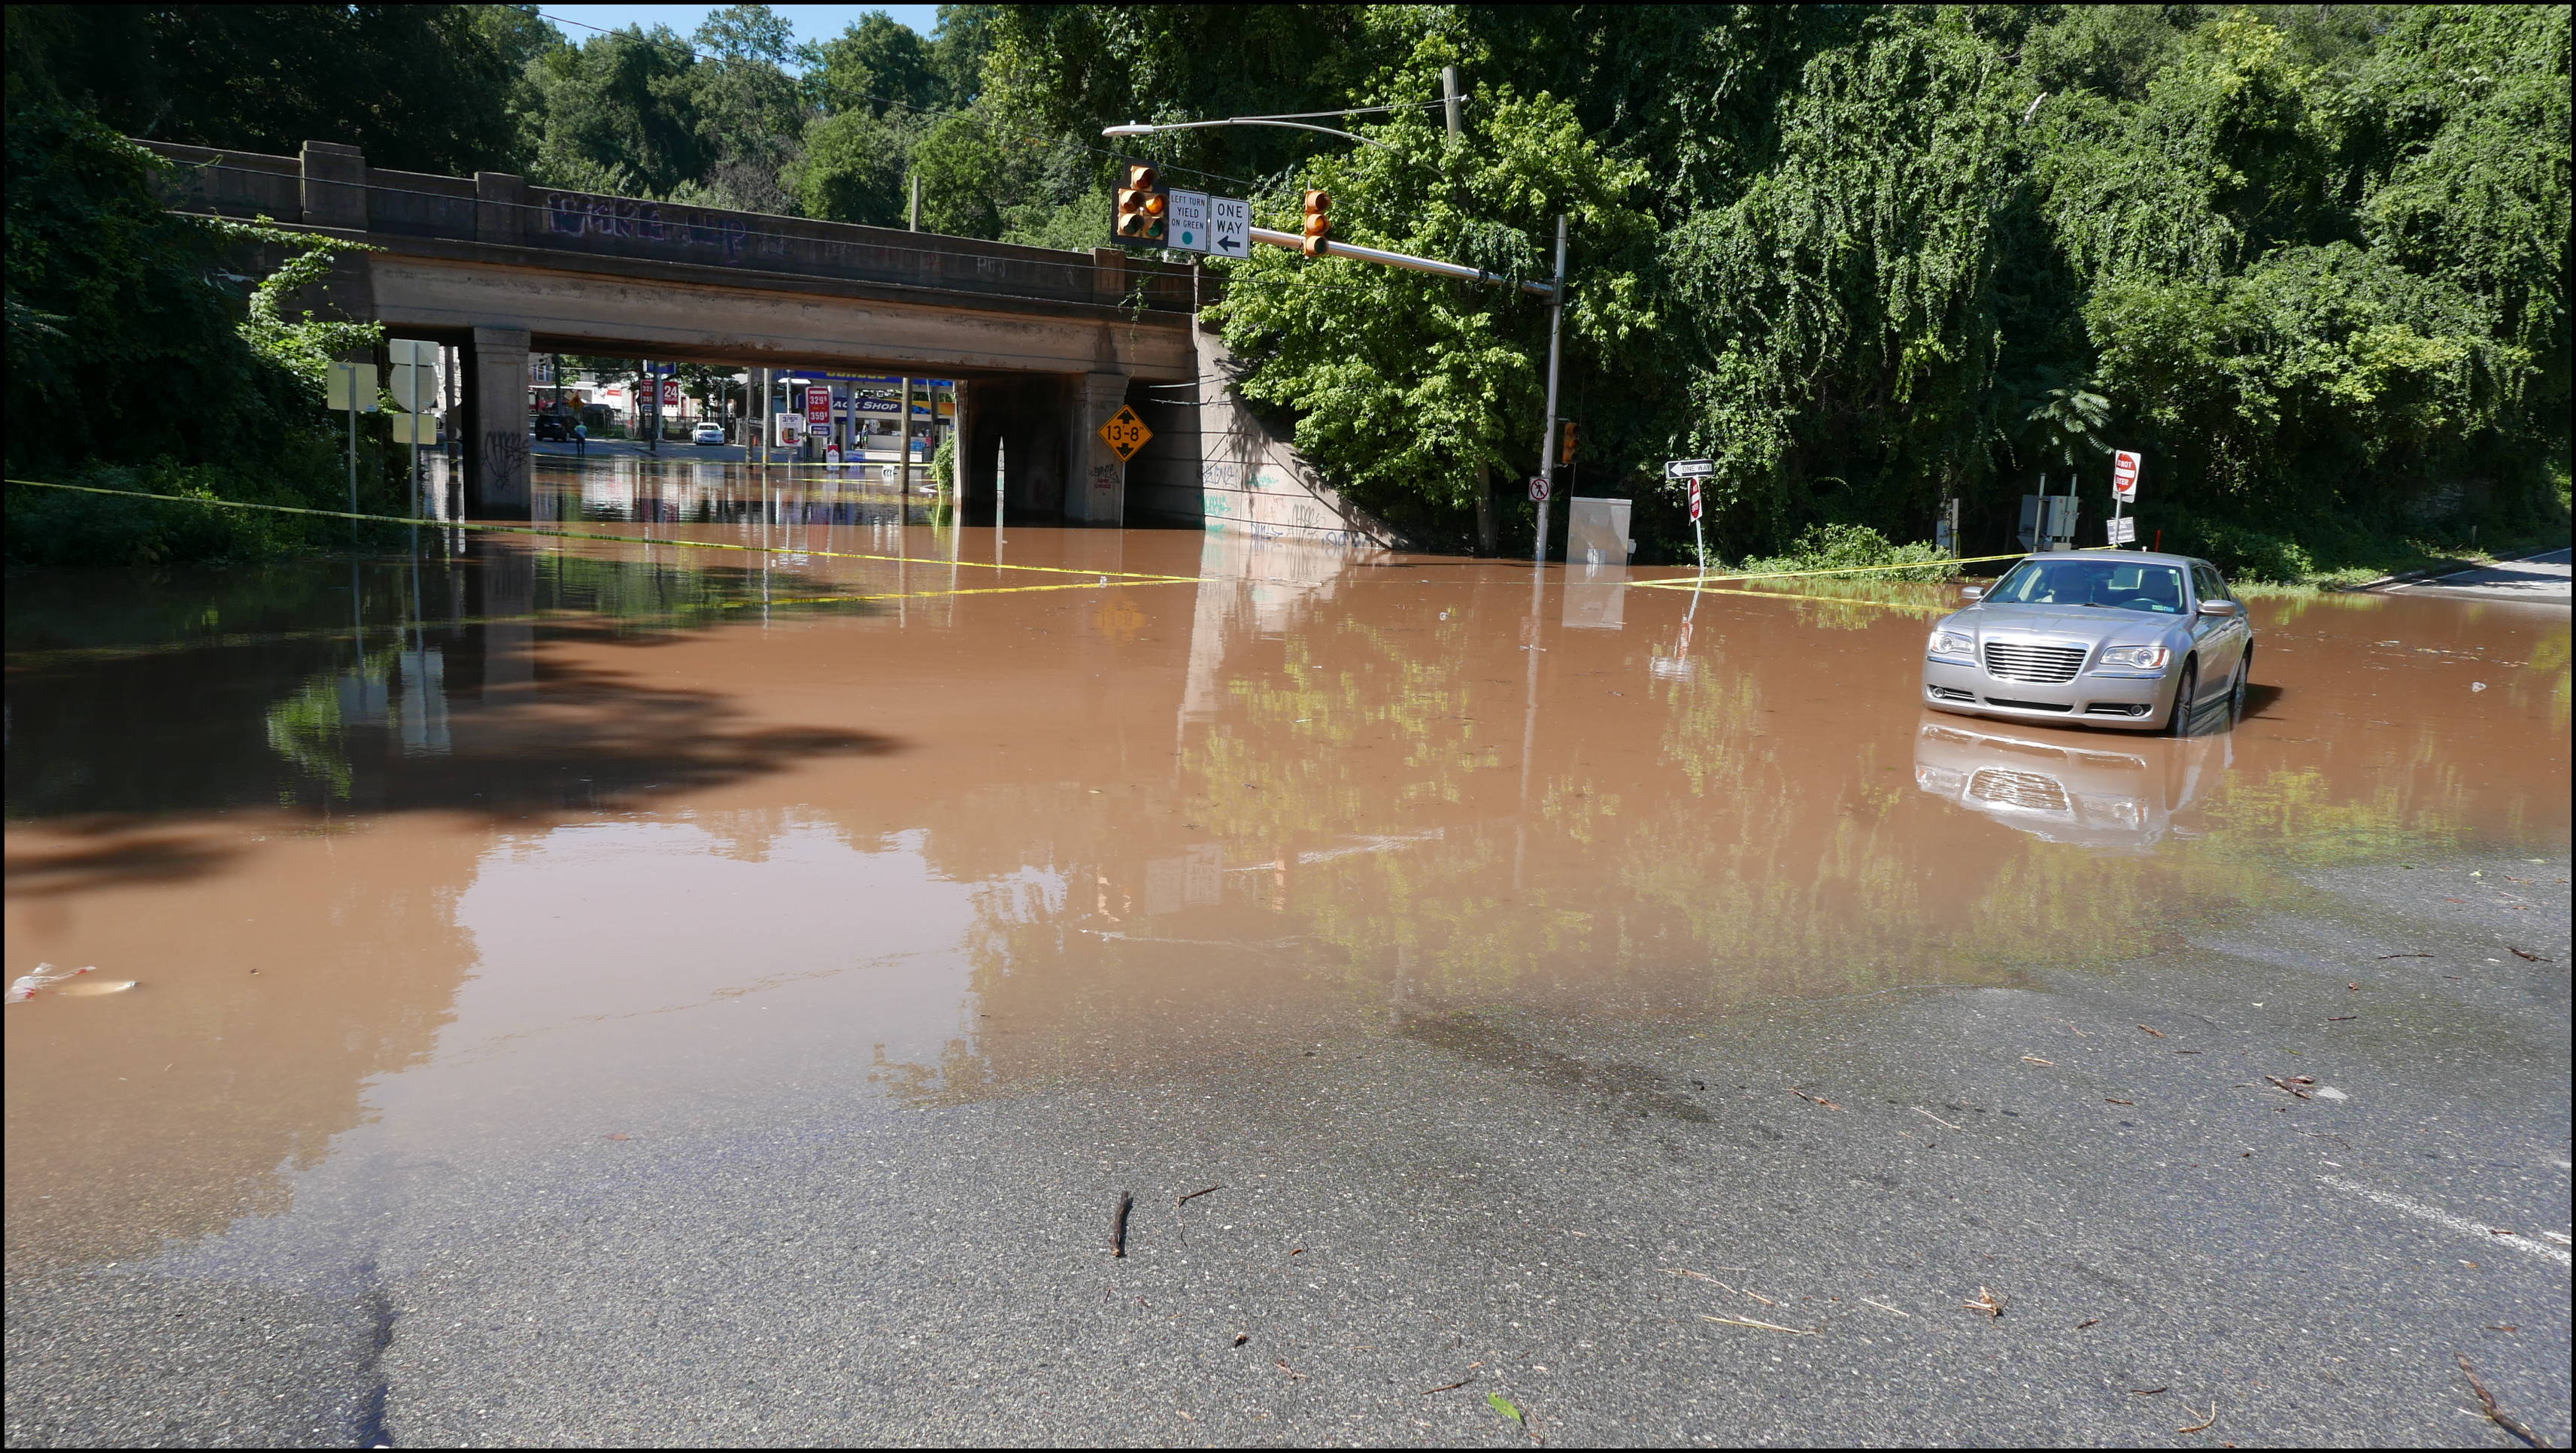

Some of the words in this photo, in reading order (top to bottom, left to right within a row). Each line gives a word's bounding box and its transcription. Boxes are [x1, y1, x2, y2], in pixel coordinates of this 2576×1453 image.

[1171, 195, 1186, 204] LEFT
[1189, 197, 1205, 206] TURN
[1177, 206, 1199, 218] YIELD
[1218, 203, 1242, 218] ONE
[1172, 218, 1180, 226] ON
[1183, 220, 1204, 229] GREEN
[1217, 220, 1242, 234] WAY
[664, 385, 678, 398] 24
[863, 402, 898, 411] SHOP
